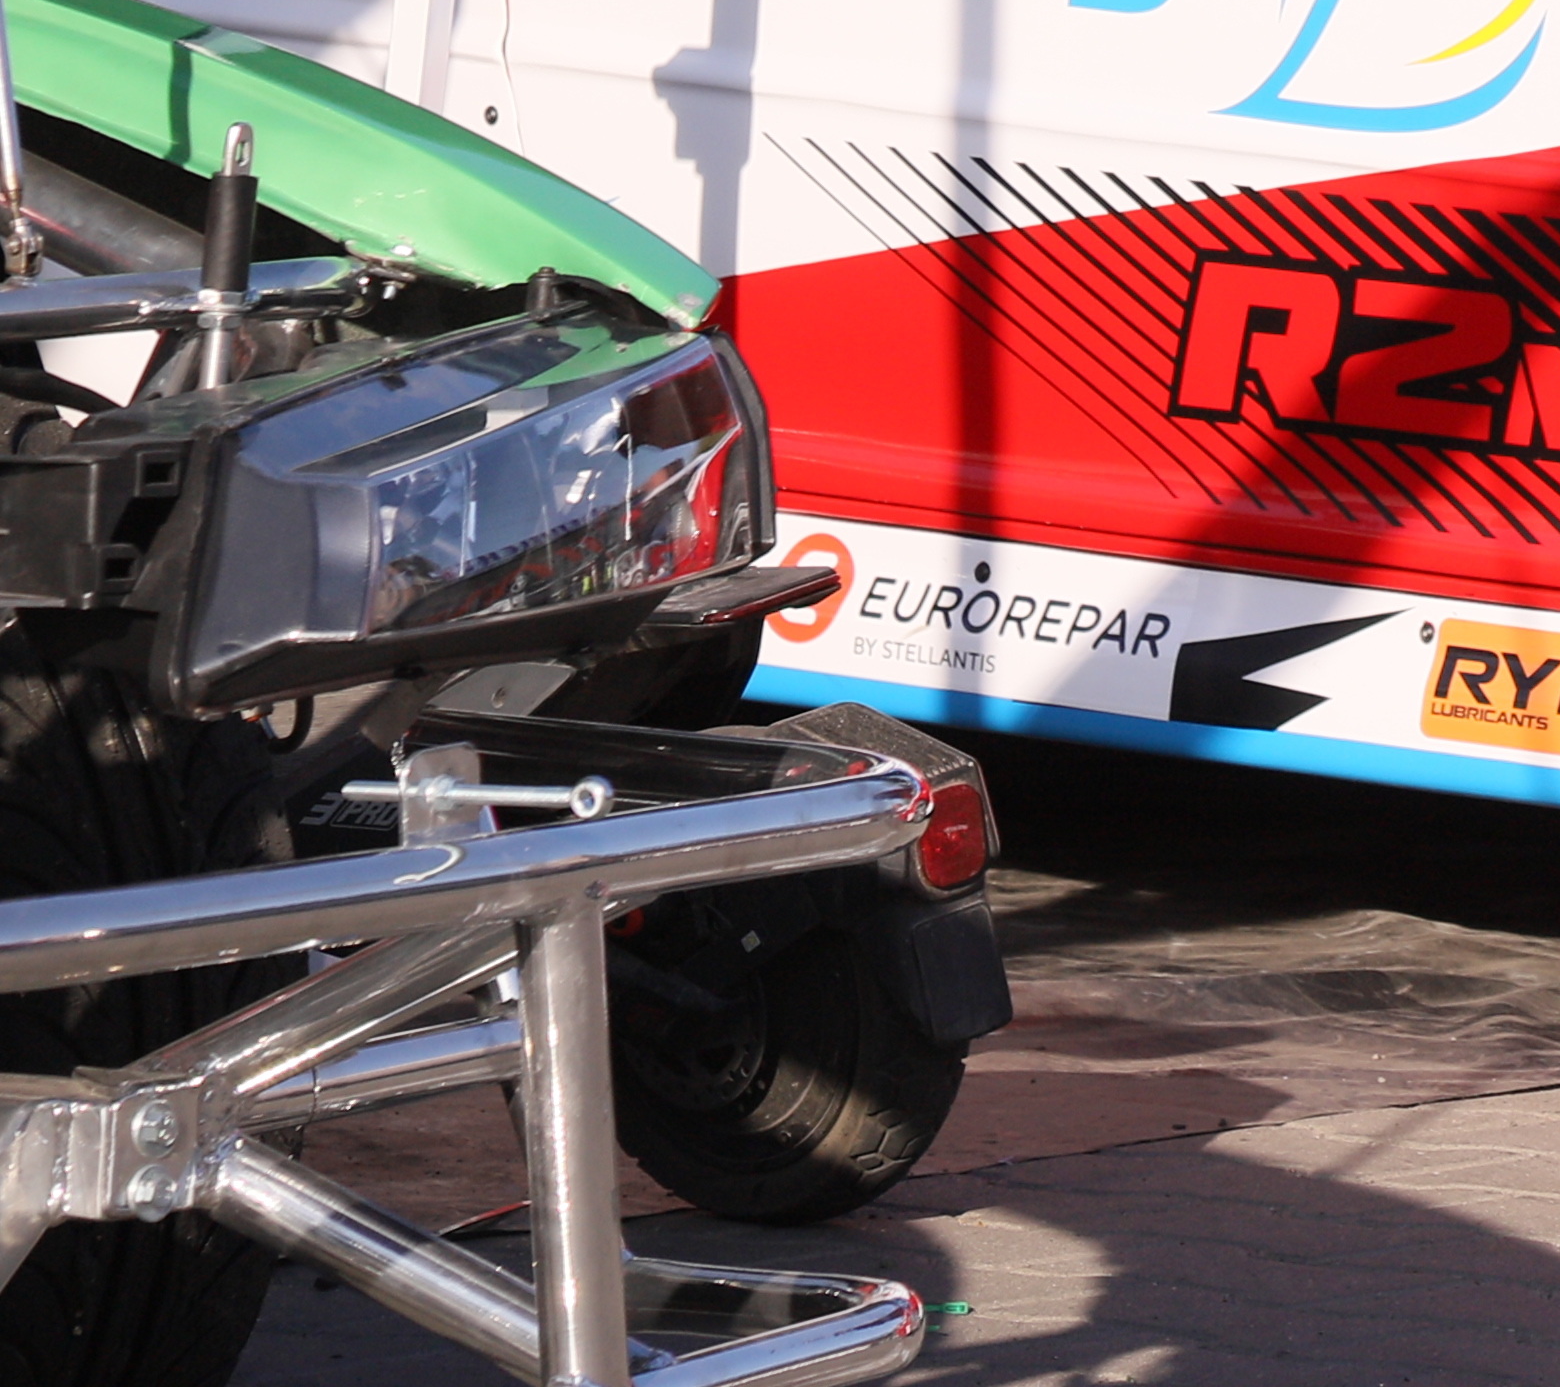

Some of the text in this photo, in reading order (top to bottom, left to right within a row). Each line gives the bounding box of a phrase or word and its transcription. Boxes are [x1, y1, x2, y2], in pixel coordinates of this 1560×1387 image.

[859, 577, 1171, 659] EUROREPAR
[853, 636, 996, 674] BY STELLANTIS
[1431, 702, 1549, 731] LUBRICANTS
